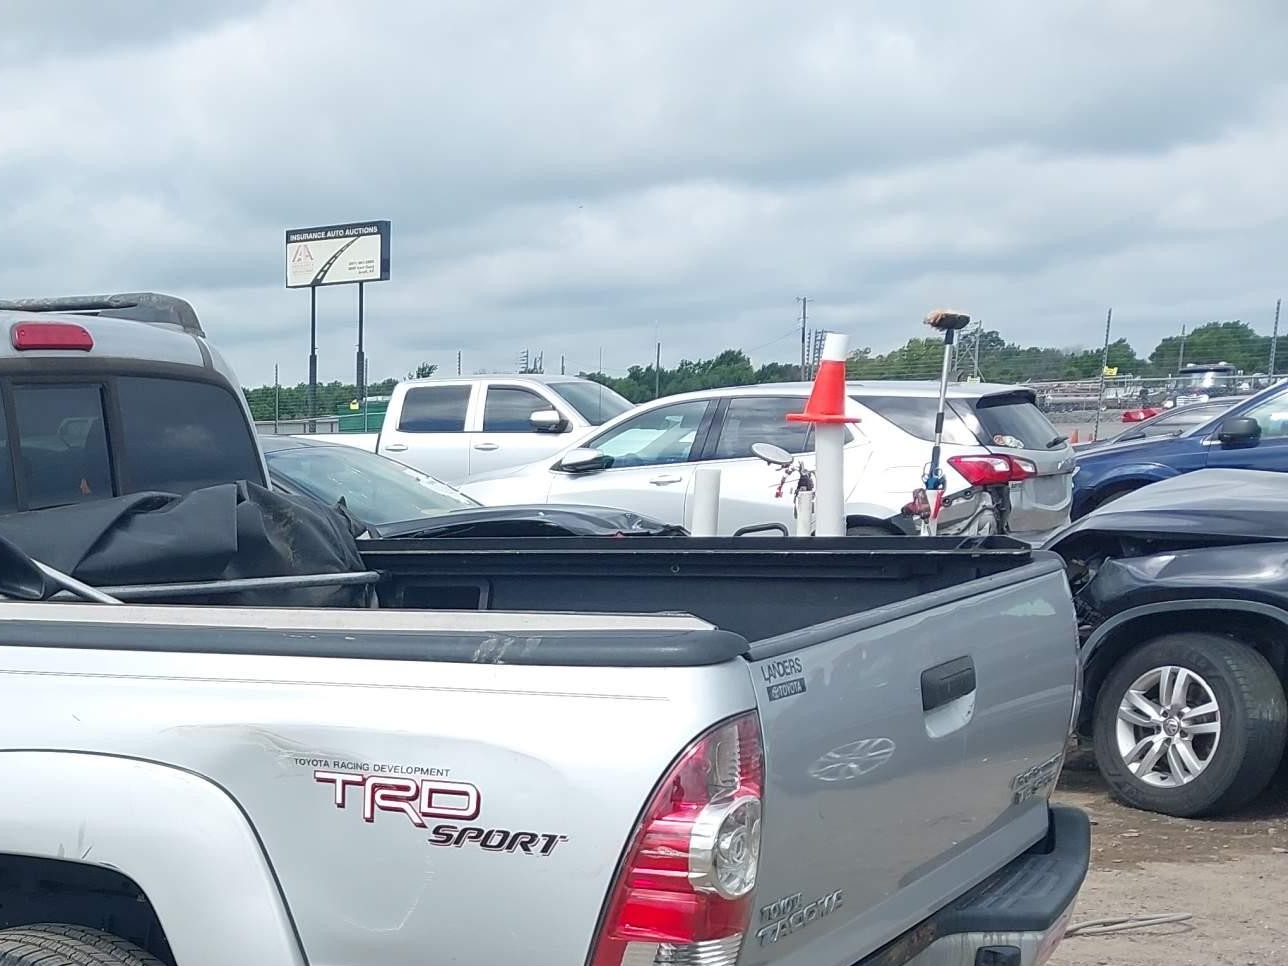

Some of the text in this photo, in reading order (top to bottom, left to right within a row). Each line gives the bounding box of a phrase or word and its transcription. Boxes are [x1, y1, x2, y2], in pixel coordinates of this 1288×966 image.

[289, 231, 326, 241] INSURANCE
[345, 226, 378, 236] AUCTIONS
[760, 657, 803, 683] LANDERS
[779, 681, 803, 697] TOYOTA
[294, 758, 452, 778] TOYOTA RACING DEVELOPMENT
[313, 769, 482, 829] TRD
[427, 824, 569, 857] SPORT
